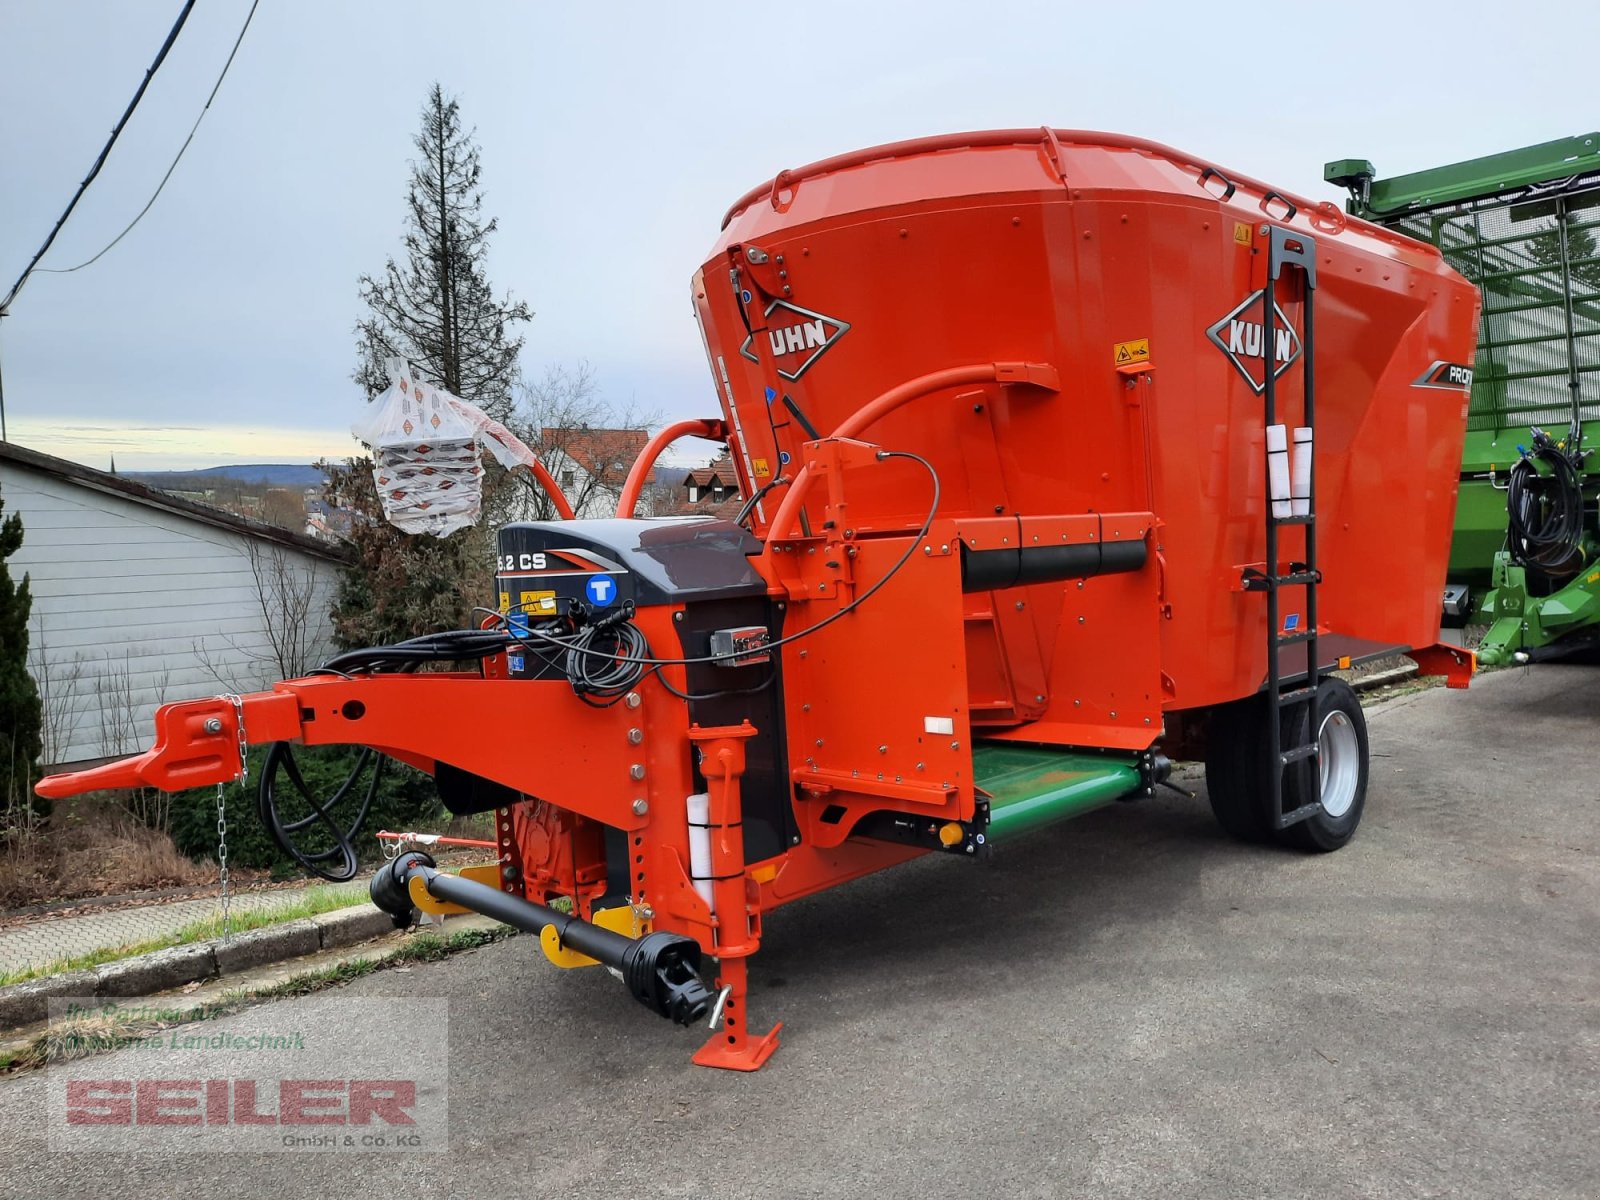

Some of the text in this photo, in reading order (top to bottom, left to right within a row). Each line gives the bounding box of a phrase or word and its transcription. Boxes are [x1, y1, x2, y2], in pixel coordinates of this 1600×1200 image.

[768, 319, 827, 356] UHN
[519, 553, 547, 570] CS
[590, 580, 611, 601] T
